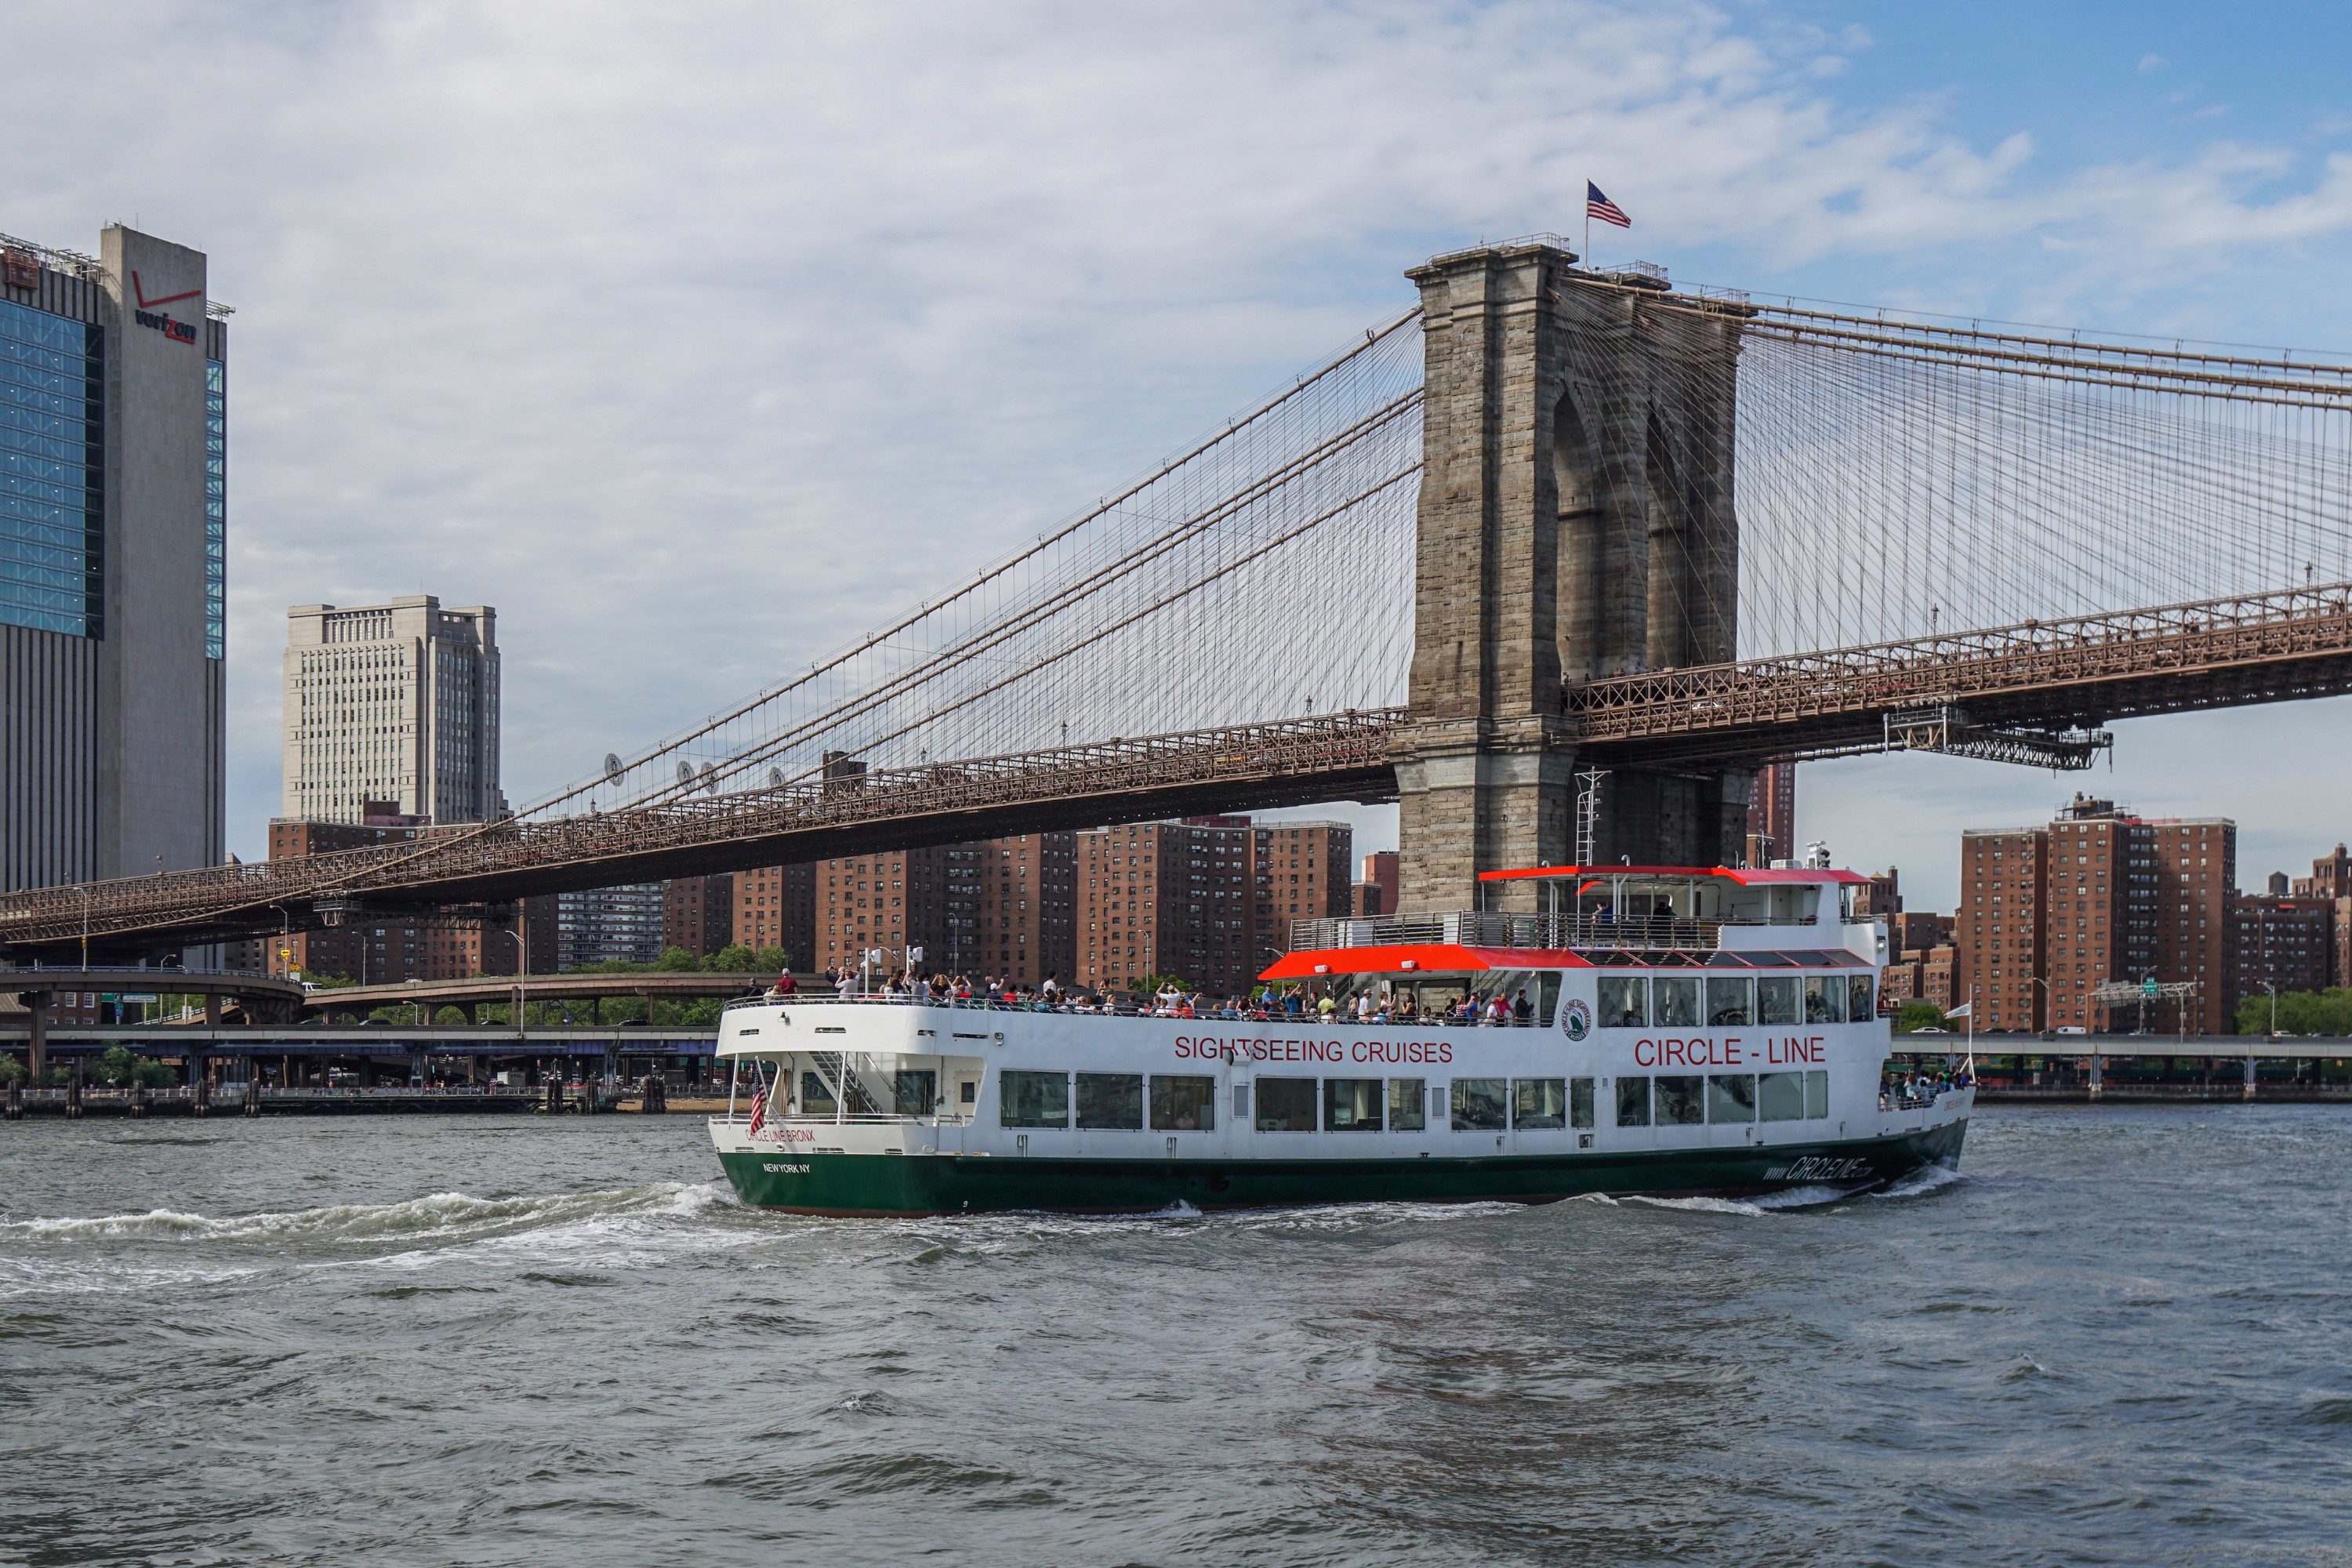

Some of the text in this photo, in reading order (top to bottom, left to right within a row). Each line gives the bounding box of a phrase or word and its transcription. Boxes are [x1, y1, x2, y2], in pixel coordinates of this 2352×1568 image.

[135, 309, 197, 344] verizon
[1174, 1036, 1453, 1063] SIGHTSEEING CRUISES
[1635, 1038, 1742, 1067] CIRCLE
[1769, 1037, 1826, 1064] LINE
[769, 1130, 786, 1142] LINE
[786, 1130, 815, 1142] BRONX
[763, 1163, 810, 1173] NEW YORK NY
